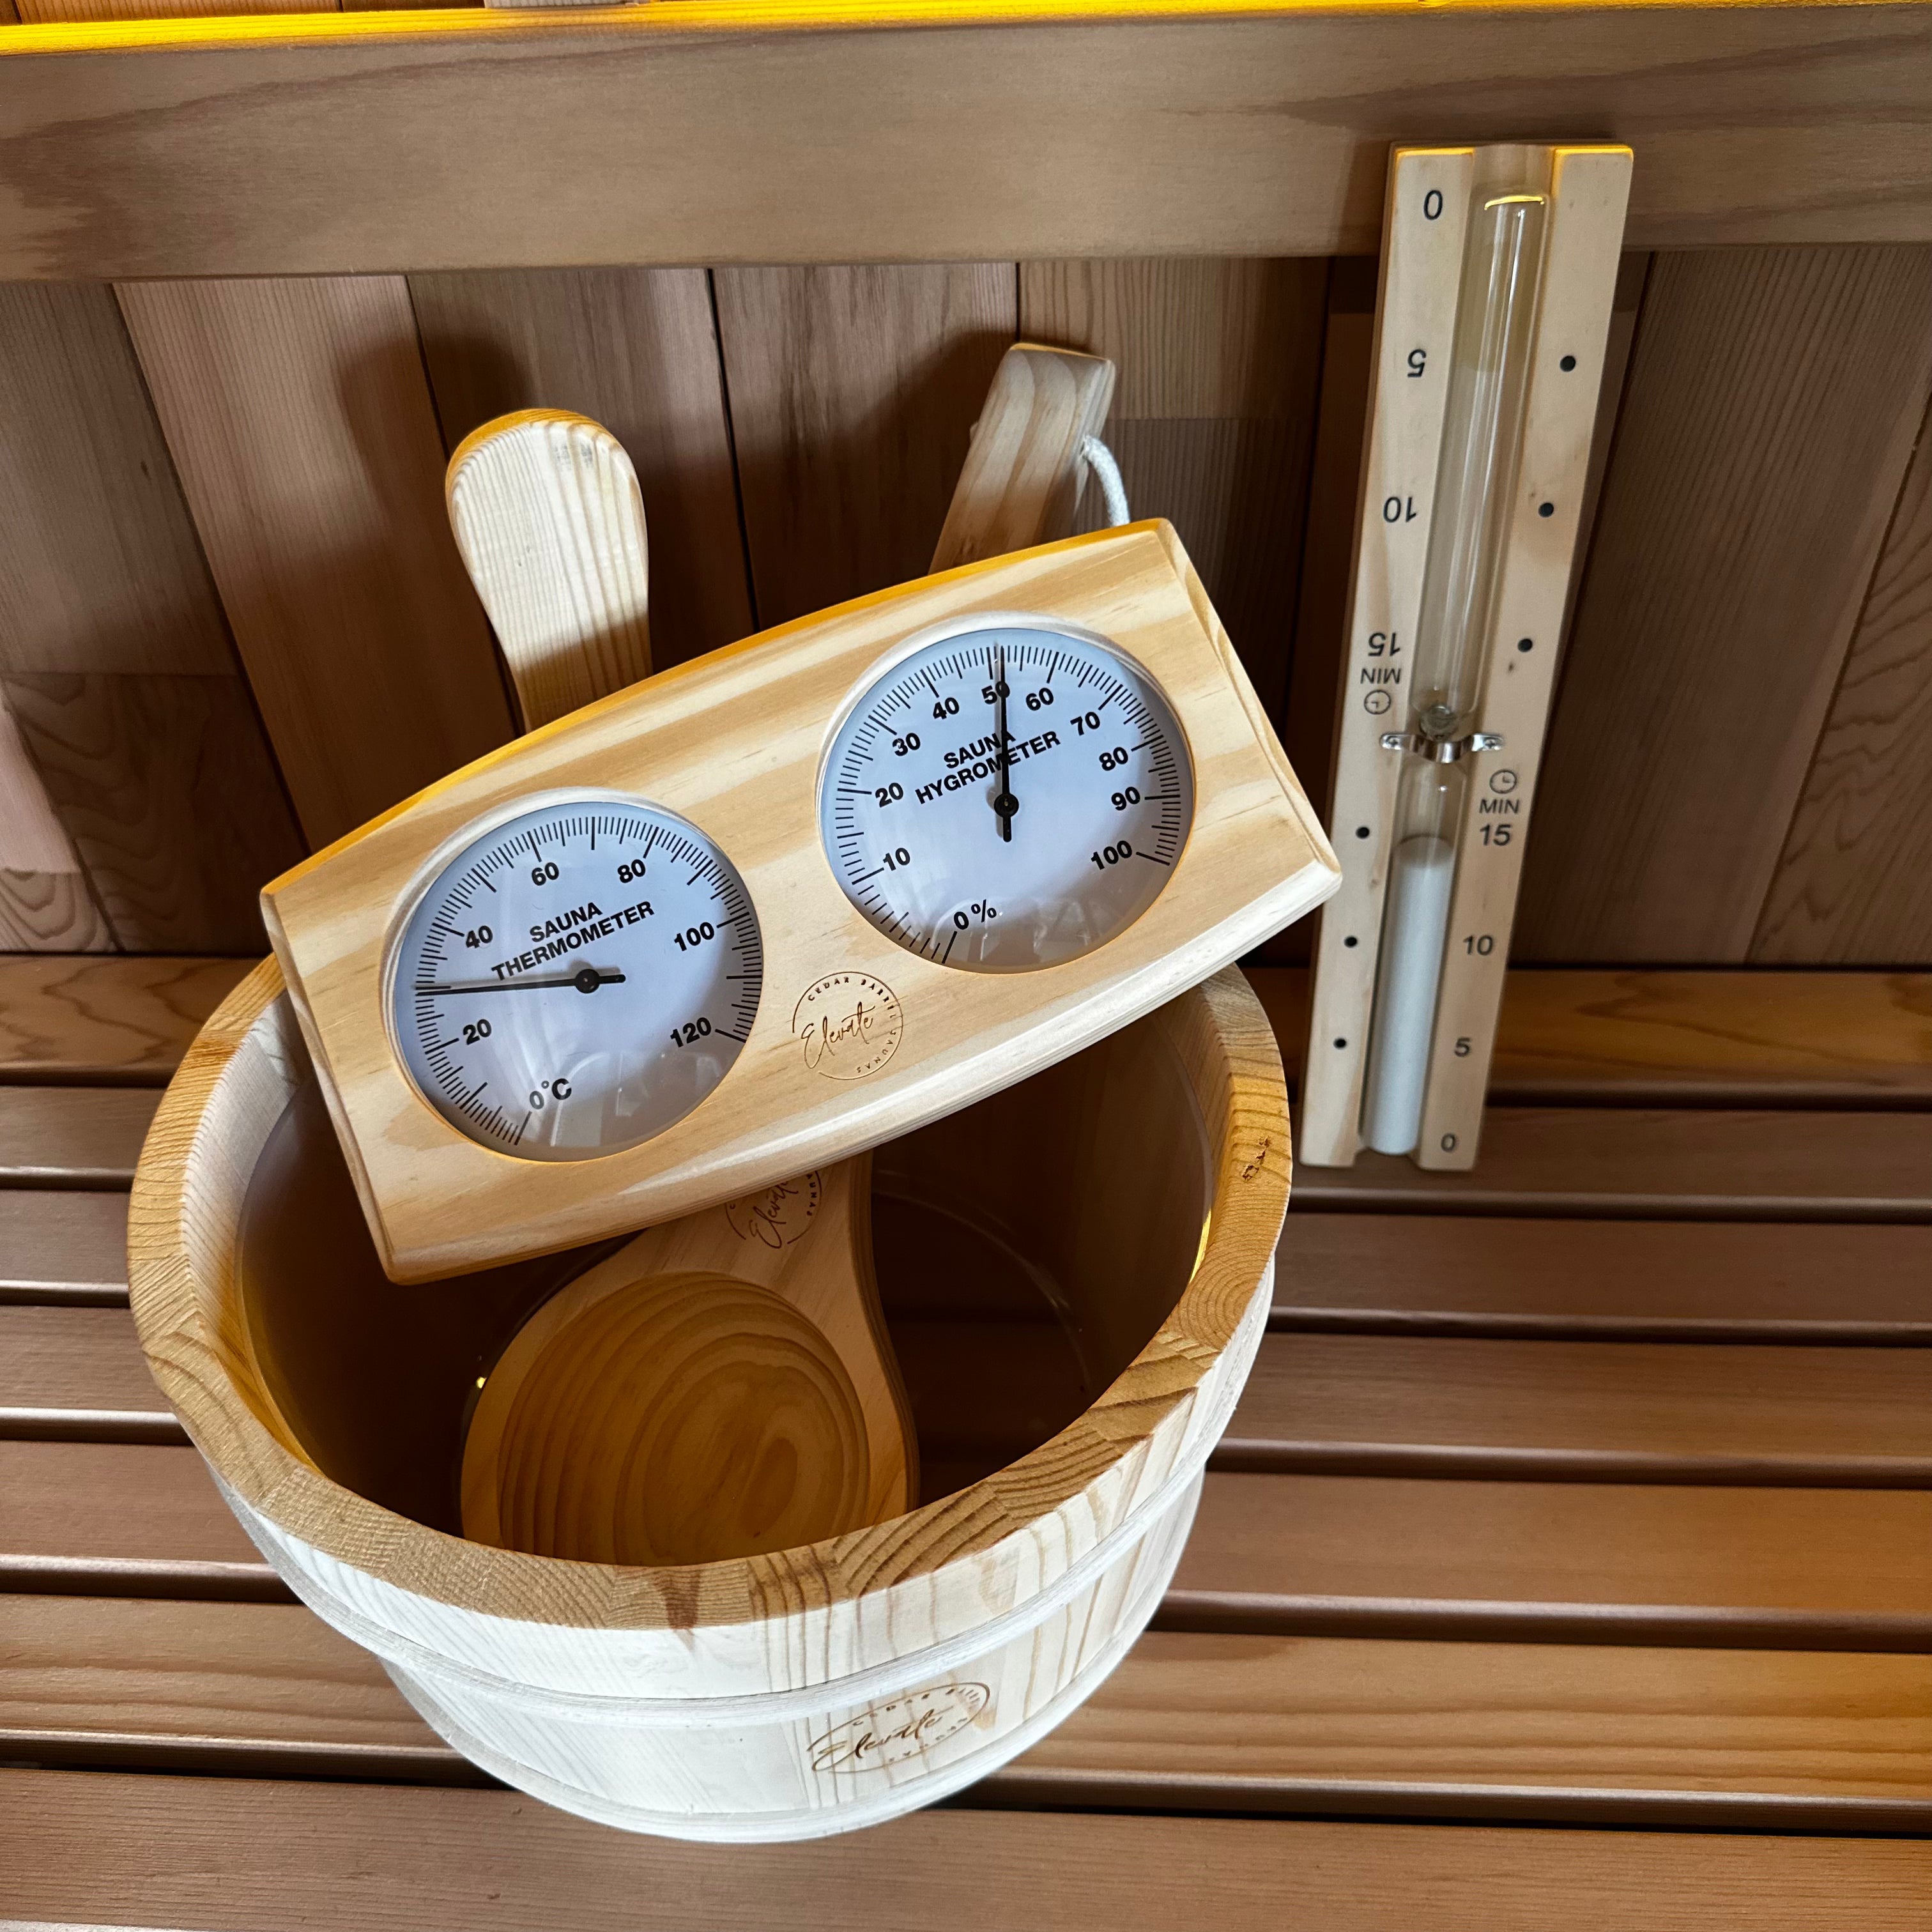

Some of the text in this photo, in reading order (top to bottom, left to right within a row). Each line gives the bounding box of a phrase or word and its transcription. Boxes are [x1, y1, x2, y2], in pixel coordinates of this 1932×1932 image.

[1423, 190, 1443, 220] 0
[1407, 349, 1427, 378] 5
[1383, 496, 1417, 523] 10
[1367, 632, 1401, 657] 15
[1360, 668, 1402, 685] MIN
[981, 681, 1011, 705] 50
[1025, 687, 1054, 712] 60
[931, 696, 960, 721] 40
[1070, 710, 1101, 737] 70
[892, 732, 921, 757] 30
[943, 730, 1016, 769] SAUNA
[914, 730, 1061, 804] HYGROMETER
[1098, 746, 1129, 771] 80
[875, 782, 904, 808] 20
[1110, 786, 1141, 811] 90
[1479, 799, 1520, 815] MIN
[1480, 824, 1512, 847] 15
[882, 847, 910, 872] 10
[1090, 839, 1133, 871] 100
[530, 861, 560, 886] 60
[617, 859, 647, 884] 80
[529, 901, 602, 943] SAUNA
[465, 924, 494, 949] 40
[491, 900, 655, 981] THERMOMETER
[673, 921, 716, 952] 100
[1463, 935, 1494, 956] 10
[463, 1018, 493, 1045] 20
[670, 1016, 712, 1048] 120
[801, 1001, 876, 1069] Elevate
[1454, 1036, 1471, 1057] 5
[1441, 1133, 1456, 1152] 0
